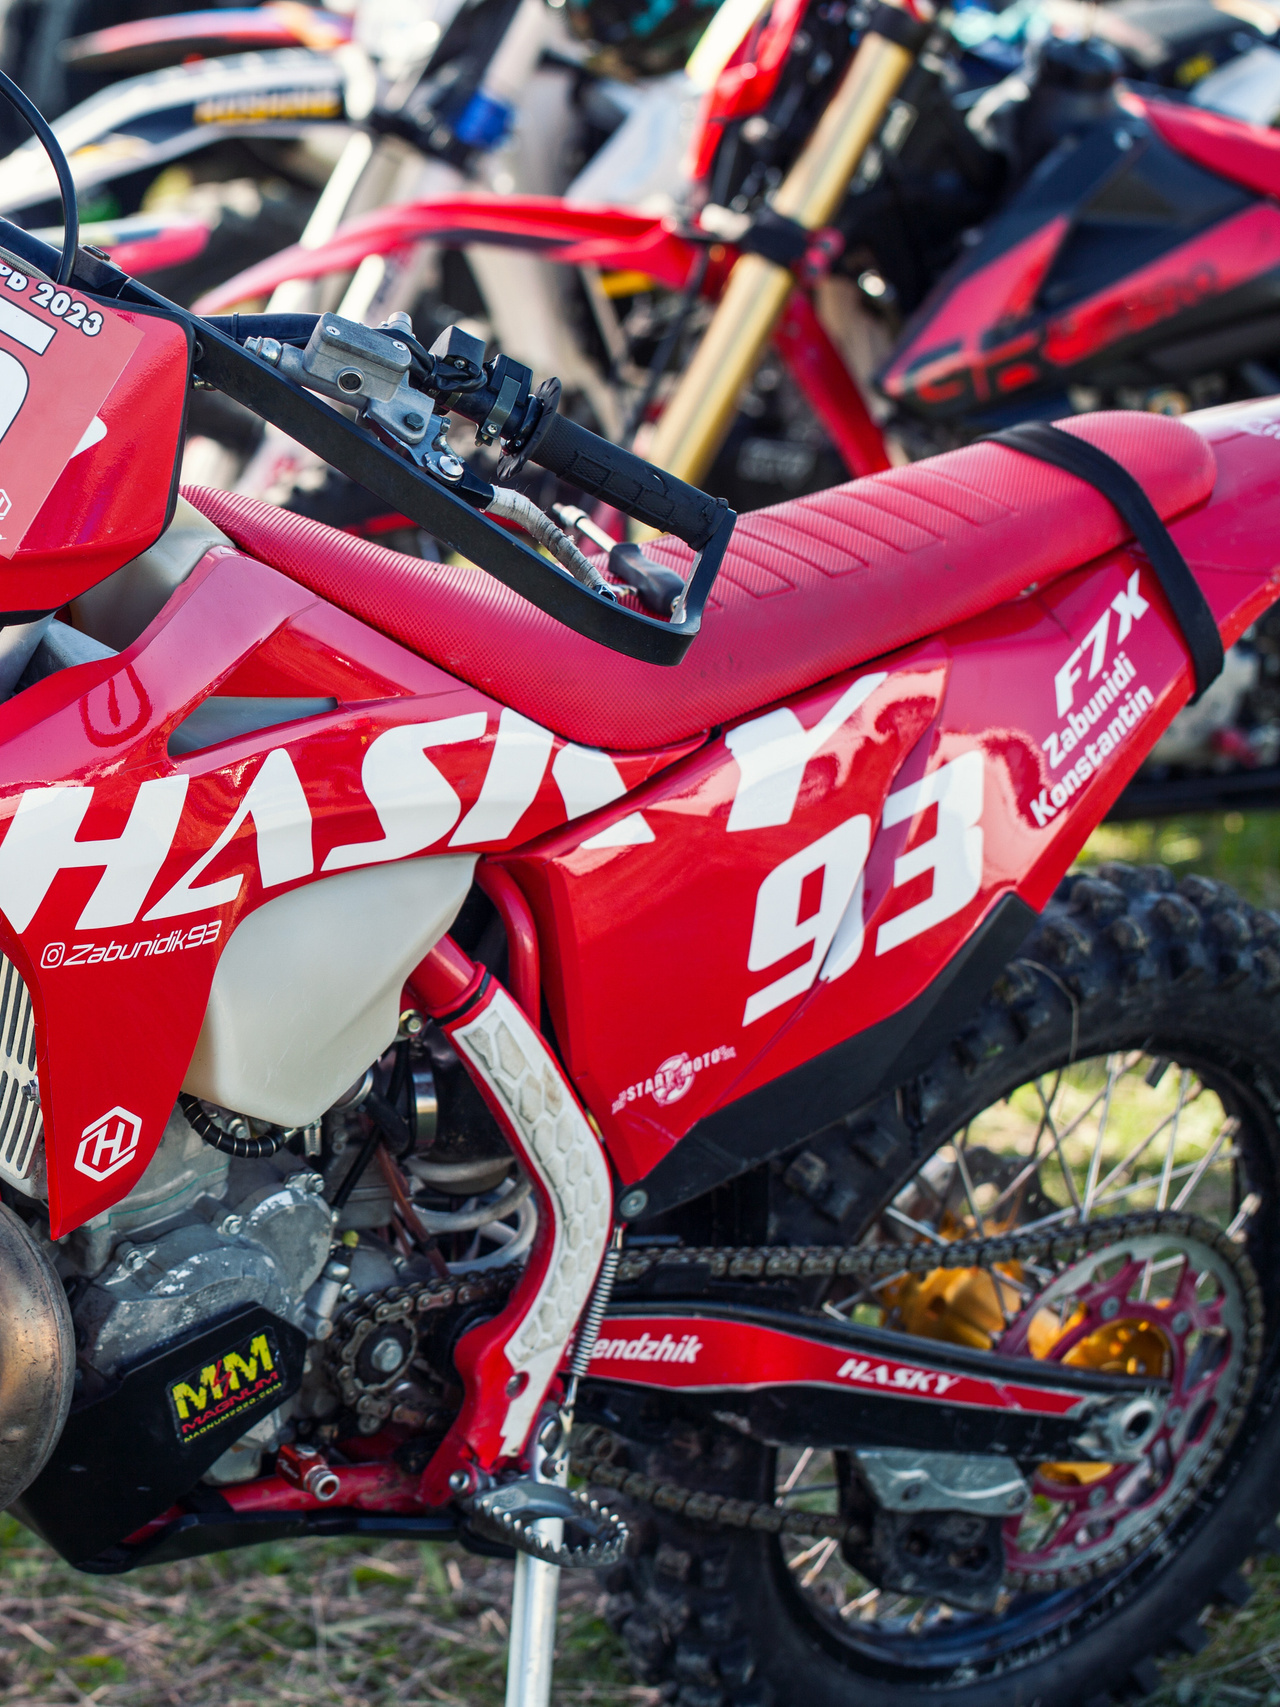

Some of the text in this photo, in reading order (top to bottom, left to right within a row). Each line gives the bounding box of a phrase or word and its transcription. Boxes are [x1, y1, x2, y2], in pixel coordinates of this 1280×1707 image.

[29, 282, 104, 336] 2023
[1054, 569, 1150, 719] F7X
[1042, 651, 1137, 770] Zabunidi
[1029, 685, 1154, 827] Konstantin
[742, 749, 985, 1027] 93
[63, 920, 222, 966] Zabunidik93
[626, 1070, 676, 1102] START
[681, 1048, 721, 1077] MOTO
[181, 1371, 279, 1434] MAGNUM
[836, 1357, 961, 1396] HASKY
